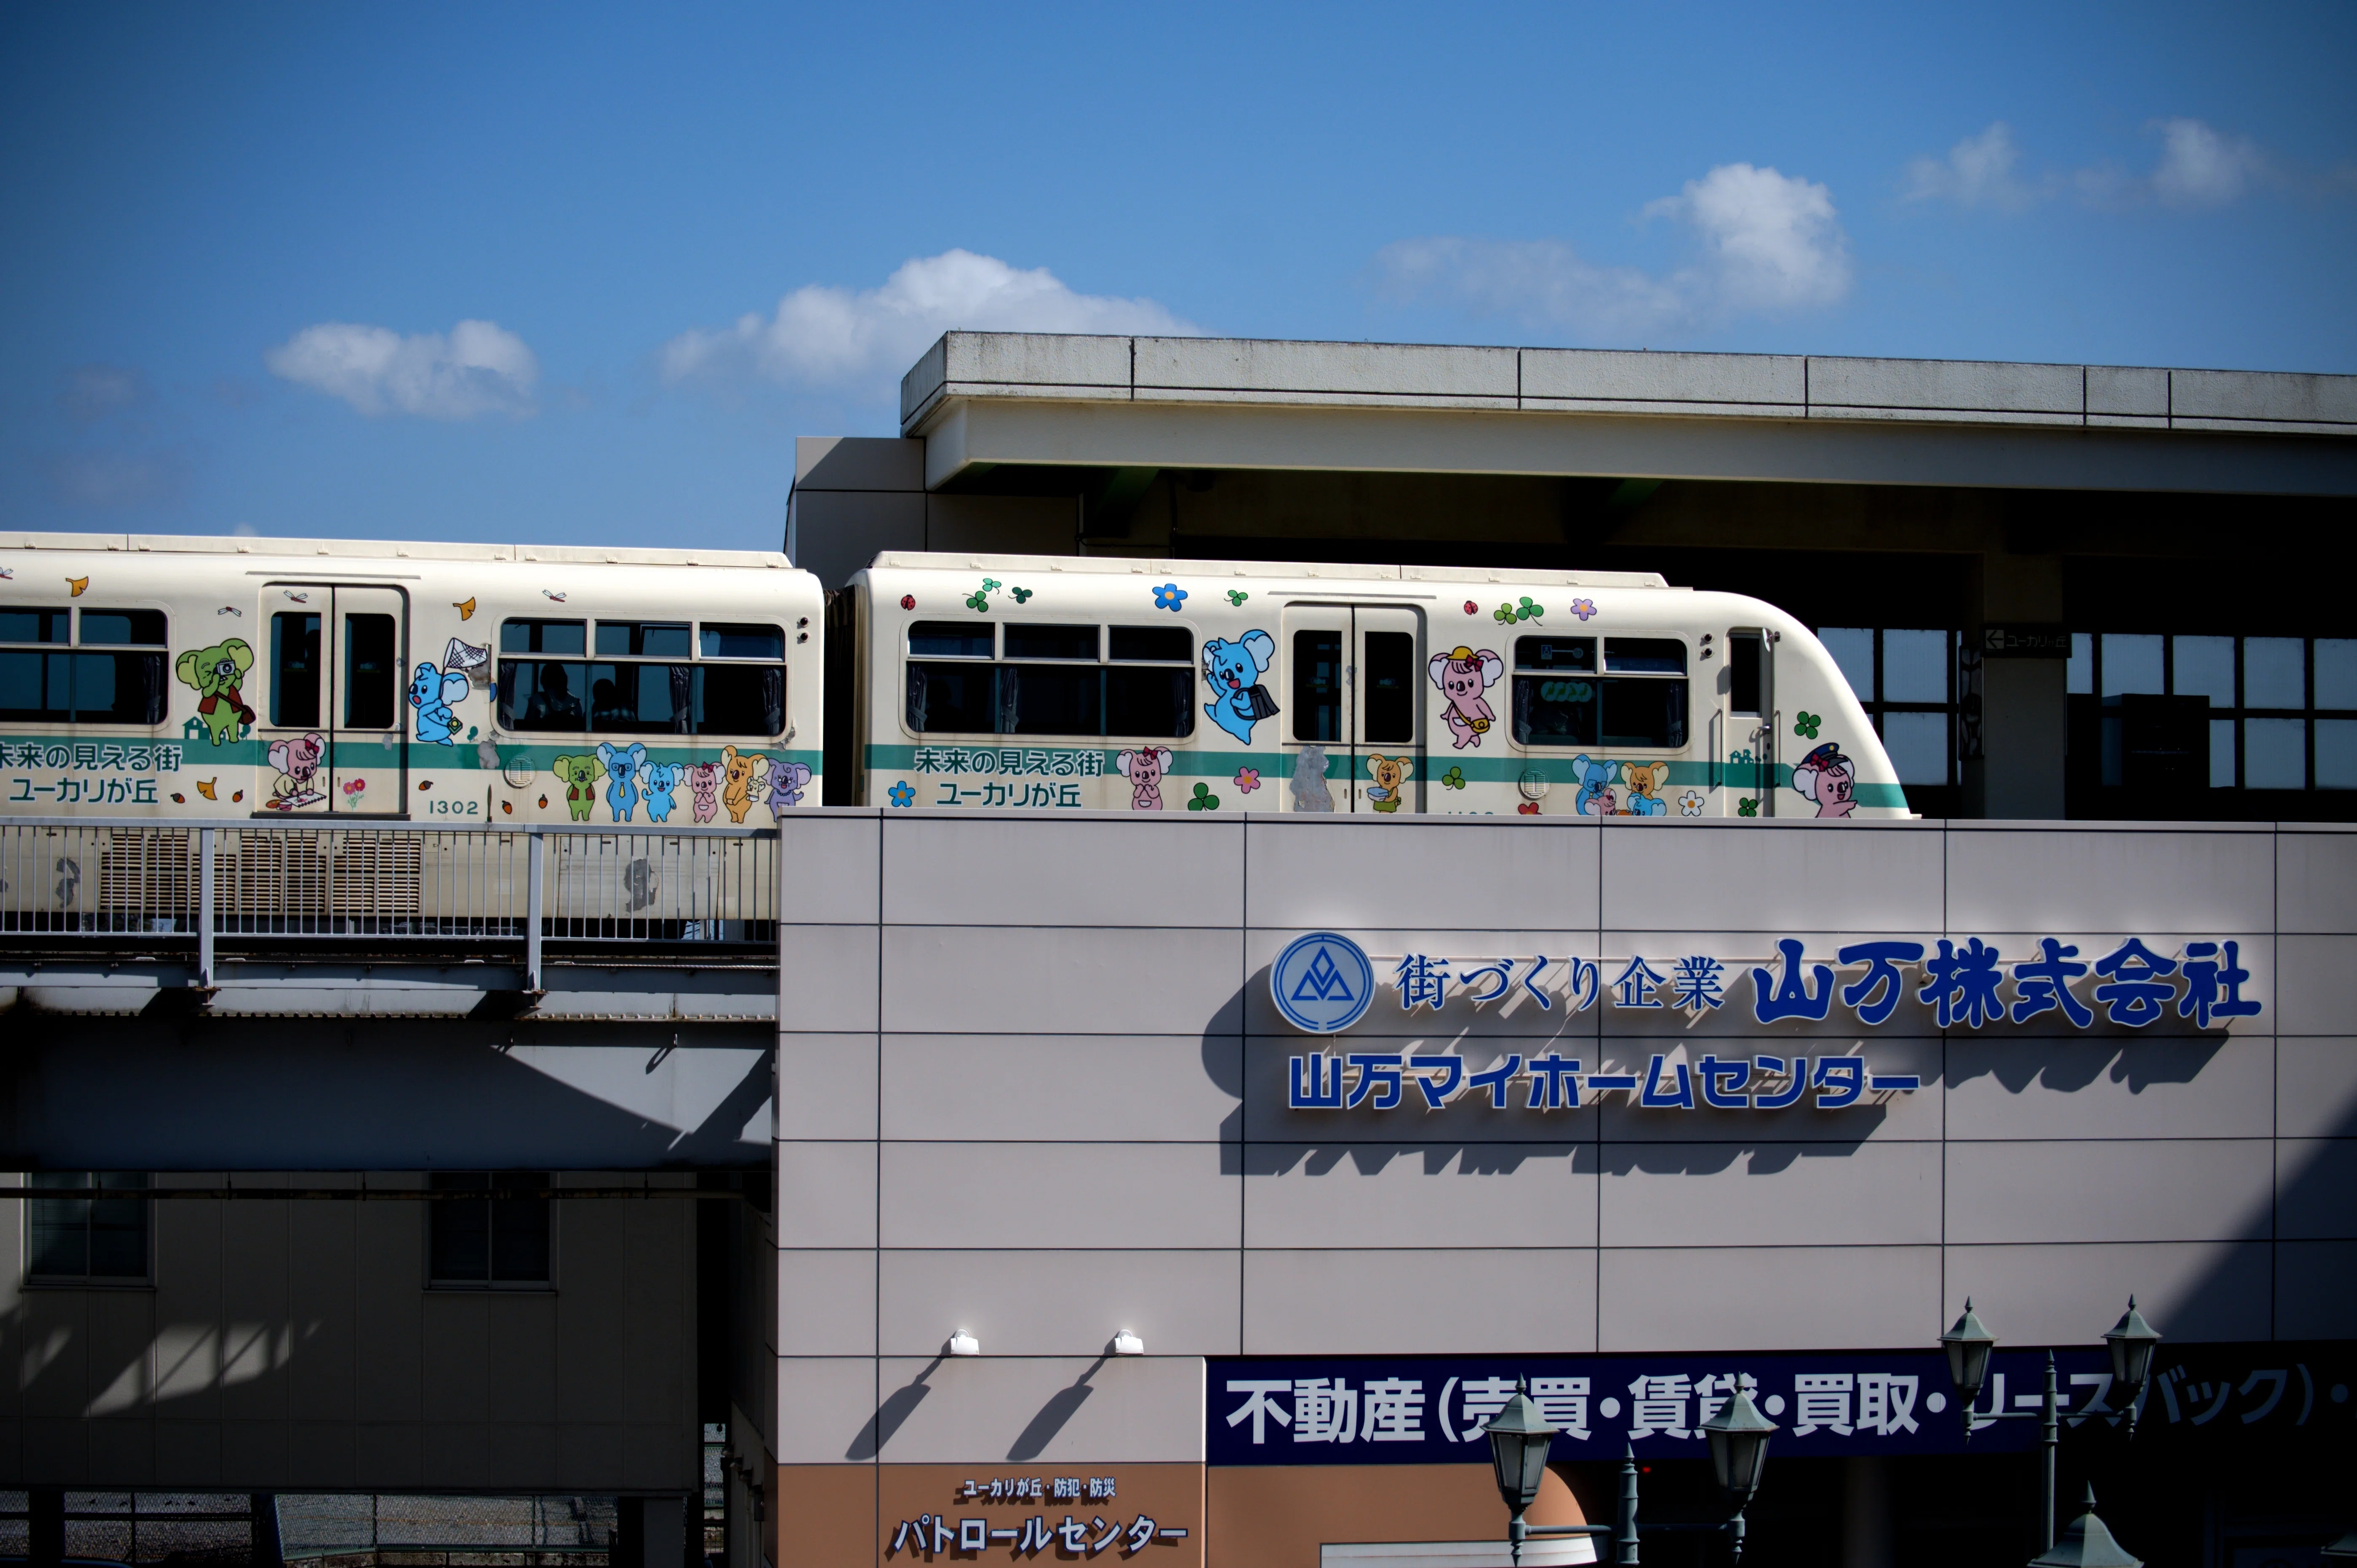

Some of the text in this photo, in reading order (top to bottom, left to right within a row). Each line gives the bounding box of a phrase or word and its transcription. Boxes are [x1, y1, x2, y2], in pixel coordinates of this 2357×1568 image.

[915, 748, 1104, 777] 未来の見える街
[9, 776, 159, 804] ユーカリが丘
[936, 781, 1082, 808] ユーカリが丘
[430, 800, 478, 815] 1302
[1393, 936, 2262, 1029] 街づくり企業 山万株式会社
[1289, 1051, 1920, 1110] 山万マイホームセンター
[964, 1477, 1117, 1499] ユーカリが丘・防犯・防災
[894, 1513, 1188, 1554] パトロールセンター
